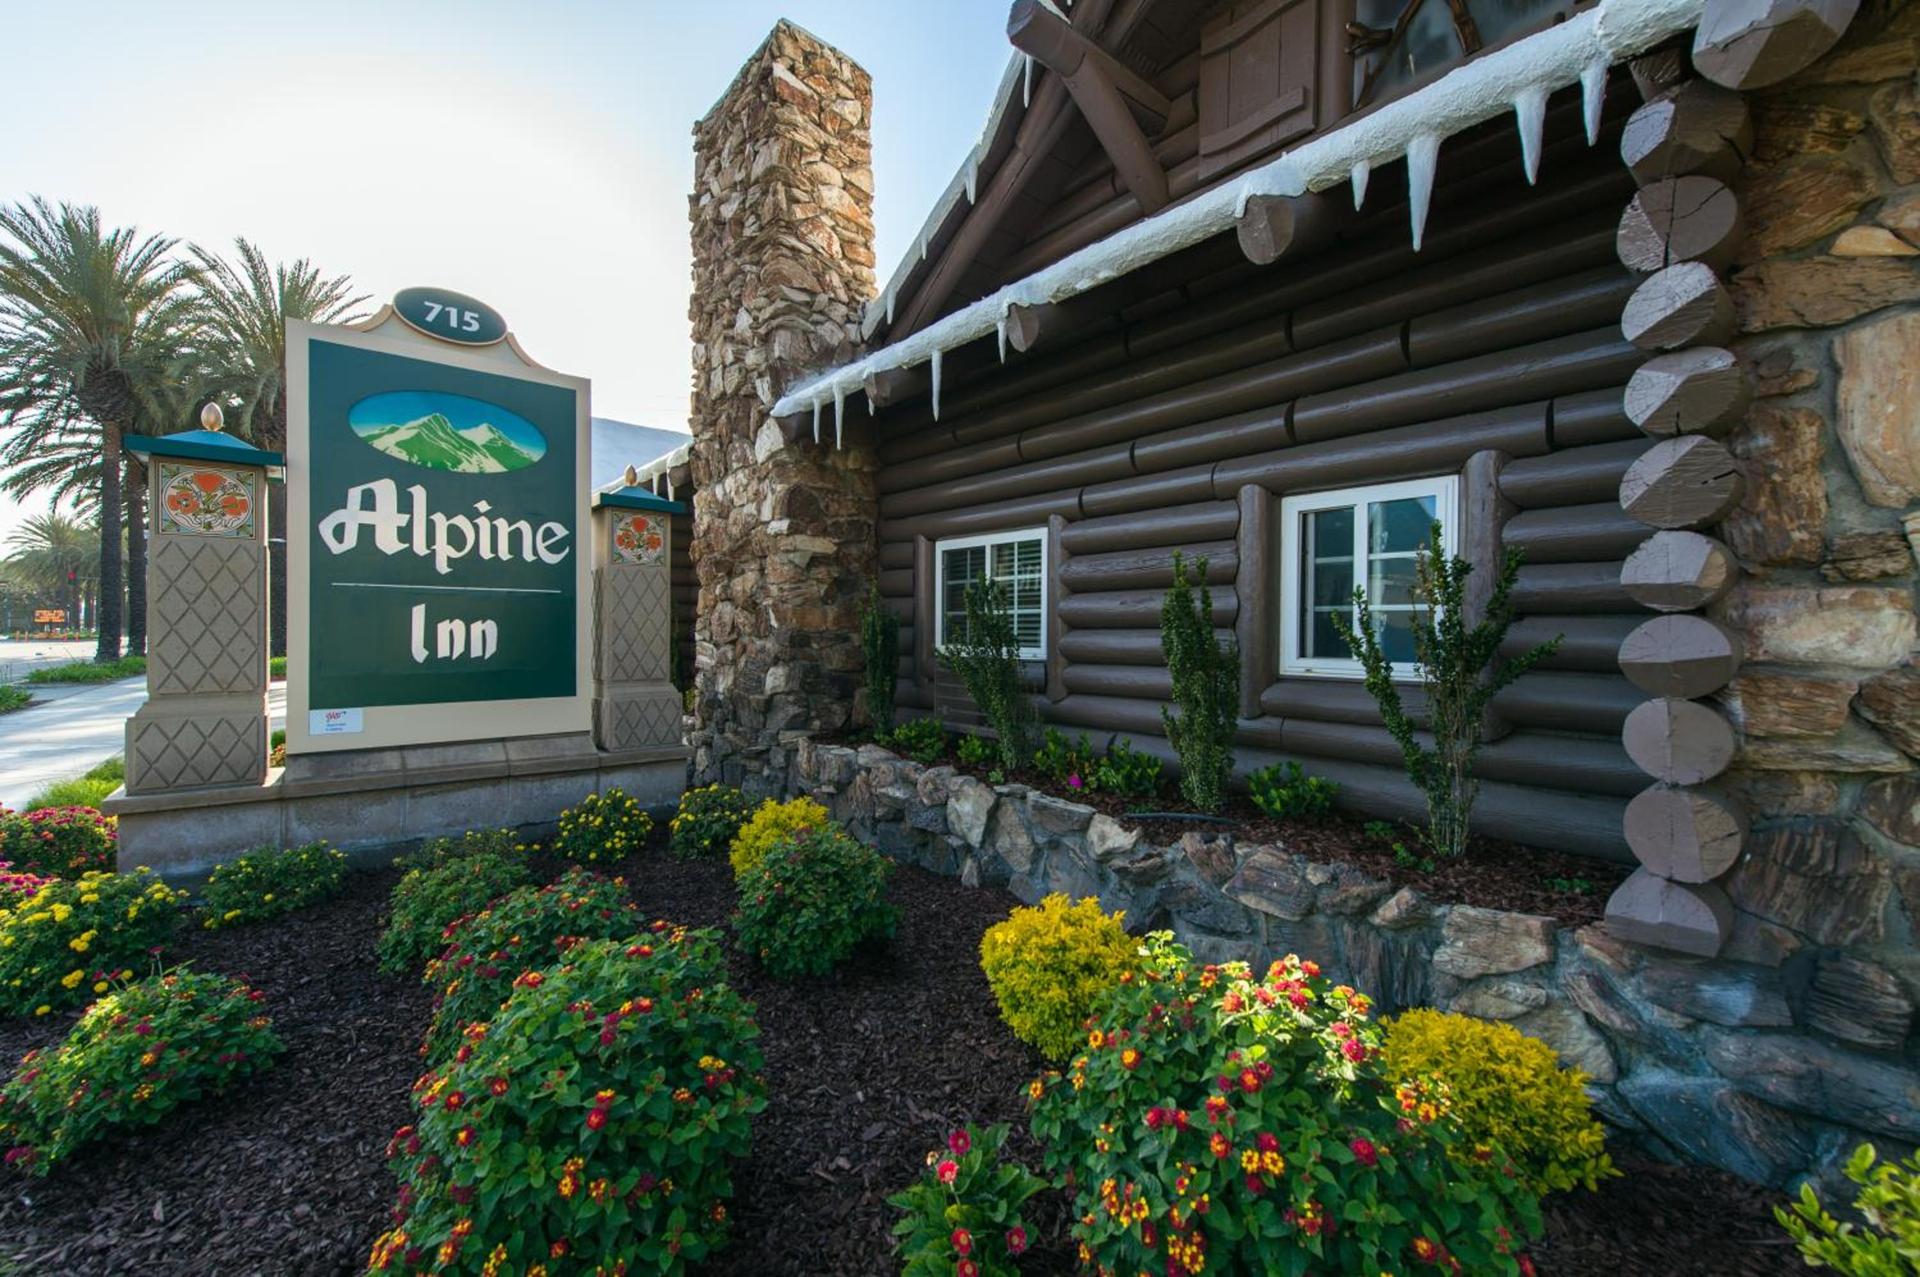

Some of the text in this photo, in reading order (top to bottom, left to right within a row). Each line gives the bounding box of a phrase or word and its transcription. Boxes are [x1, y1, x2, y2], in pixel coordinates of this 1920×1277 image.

[424, 301, 480, 332] 715
[318, 478, 570, 575] Alpine
[411, 603, 498, 663] Inn
